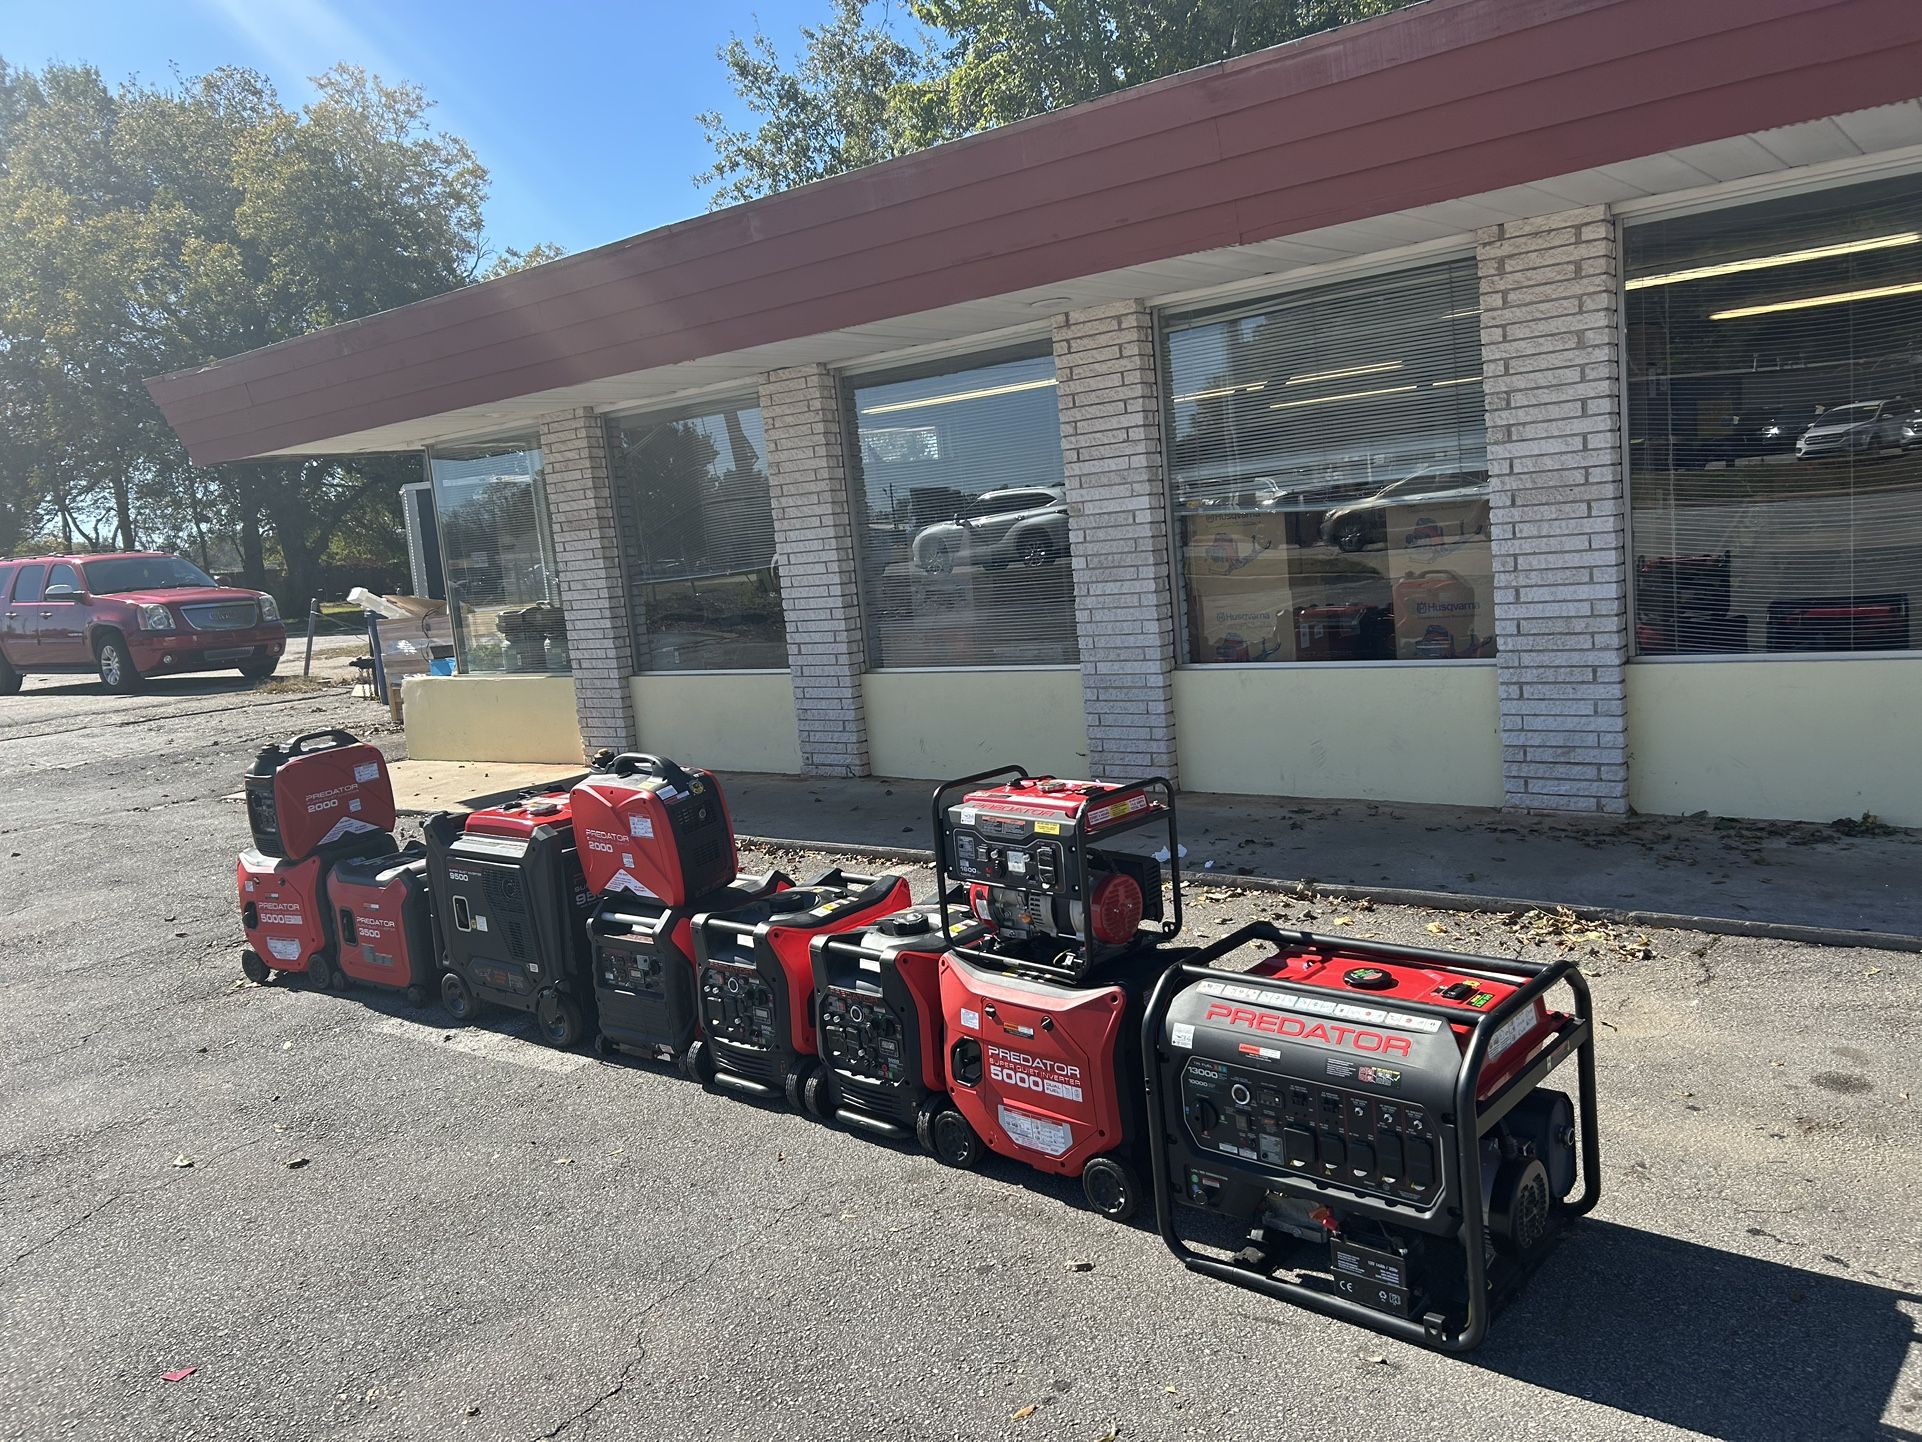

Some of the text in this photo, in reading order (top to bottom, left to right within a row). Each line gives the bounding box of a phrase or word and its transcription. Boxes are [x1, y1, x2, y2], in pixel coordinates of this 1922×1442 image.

[1427, 601, 1480, 612] Husqvarna
[306, 783, 359, 801] PREDATOR
[307, 799, 338, 813] 2000
[585, 828, 630, 842] PREDATOR
[588, 841, 613, 853] 2000
[449, 872, 469, 881] 9500
[258, 902, 300, 911] PREDATOR
[260, 913, 285, 924] 5000
[356, 916, 395, 928] PREDATOR
[359, 927, 380, 938] 3500
[1205, 1002, 1413, 1057] PREDATOR
[988, 1045, 1080, 1078] PREDATOR
[989, 1057, 1081, 1086] SUPER QUIET INVERTER
[1188, 1066, 1218, 1079] 13000
[990, 1065, 1043, 1092] 5000
[1046, 1081, 1061, 1090] DUAL
